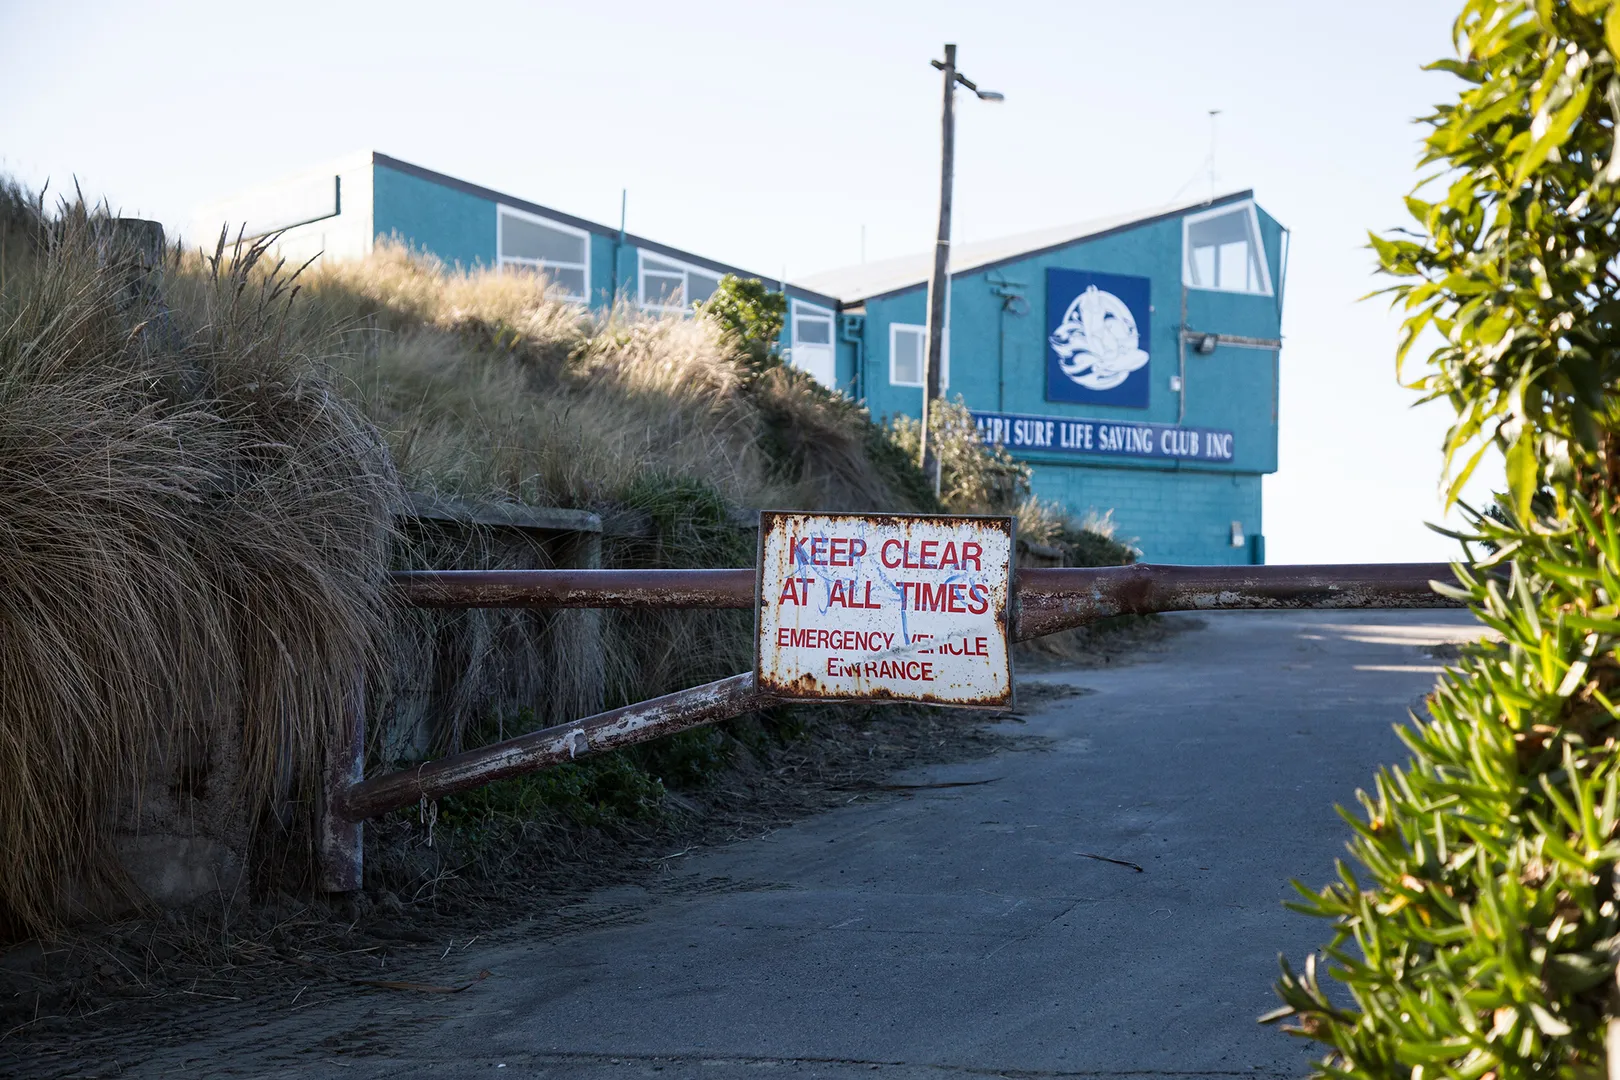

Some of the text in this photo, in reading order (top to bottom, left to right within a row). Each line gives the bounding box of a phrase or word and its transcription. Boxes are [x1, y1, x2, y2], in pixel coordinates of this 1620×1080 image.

[1014, 420, 1055, 447] SURF
[1060, 422, 1093, 449] LIFE
[1099, 425, 1153, 453] SAVING
[1161, 430, 1199, 457] CLUB
[1206, 433, 1233, 459] INC
[789, 536, 983, 571] KEEP CLEAR
[779, 578, 989, 615] AT ALL TIMES
[777, 628, 895, 651] EMERGENCY
